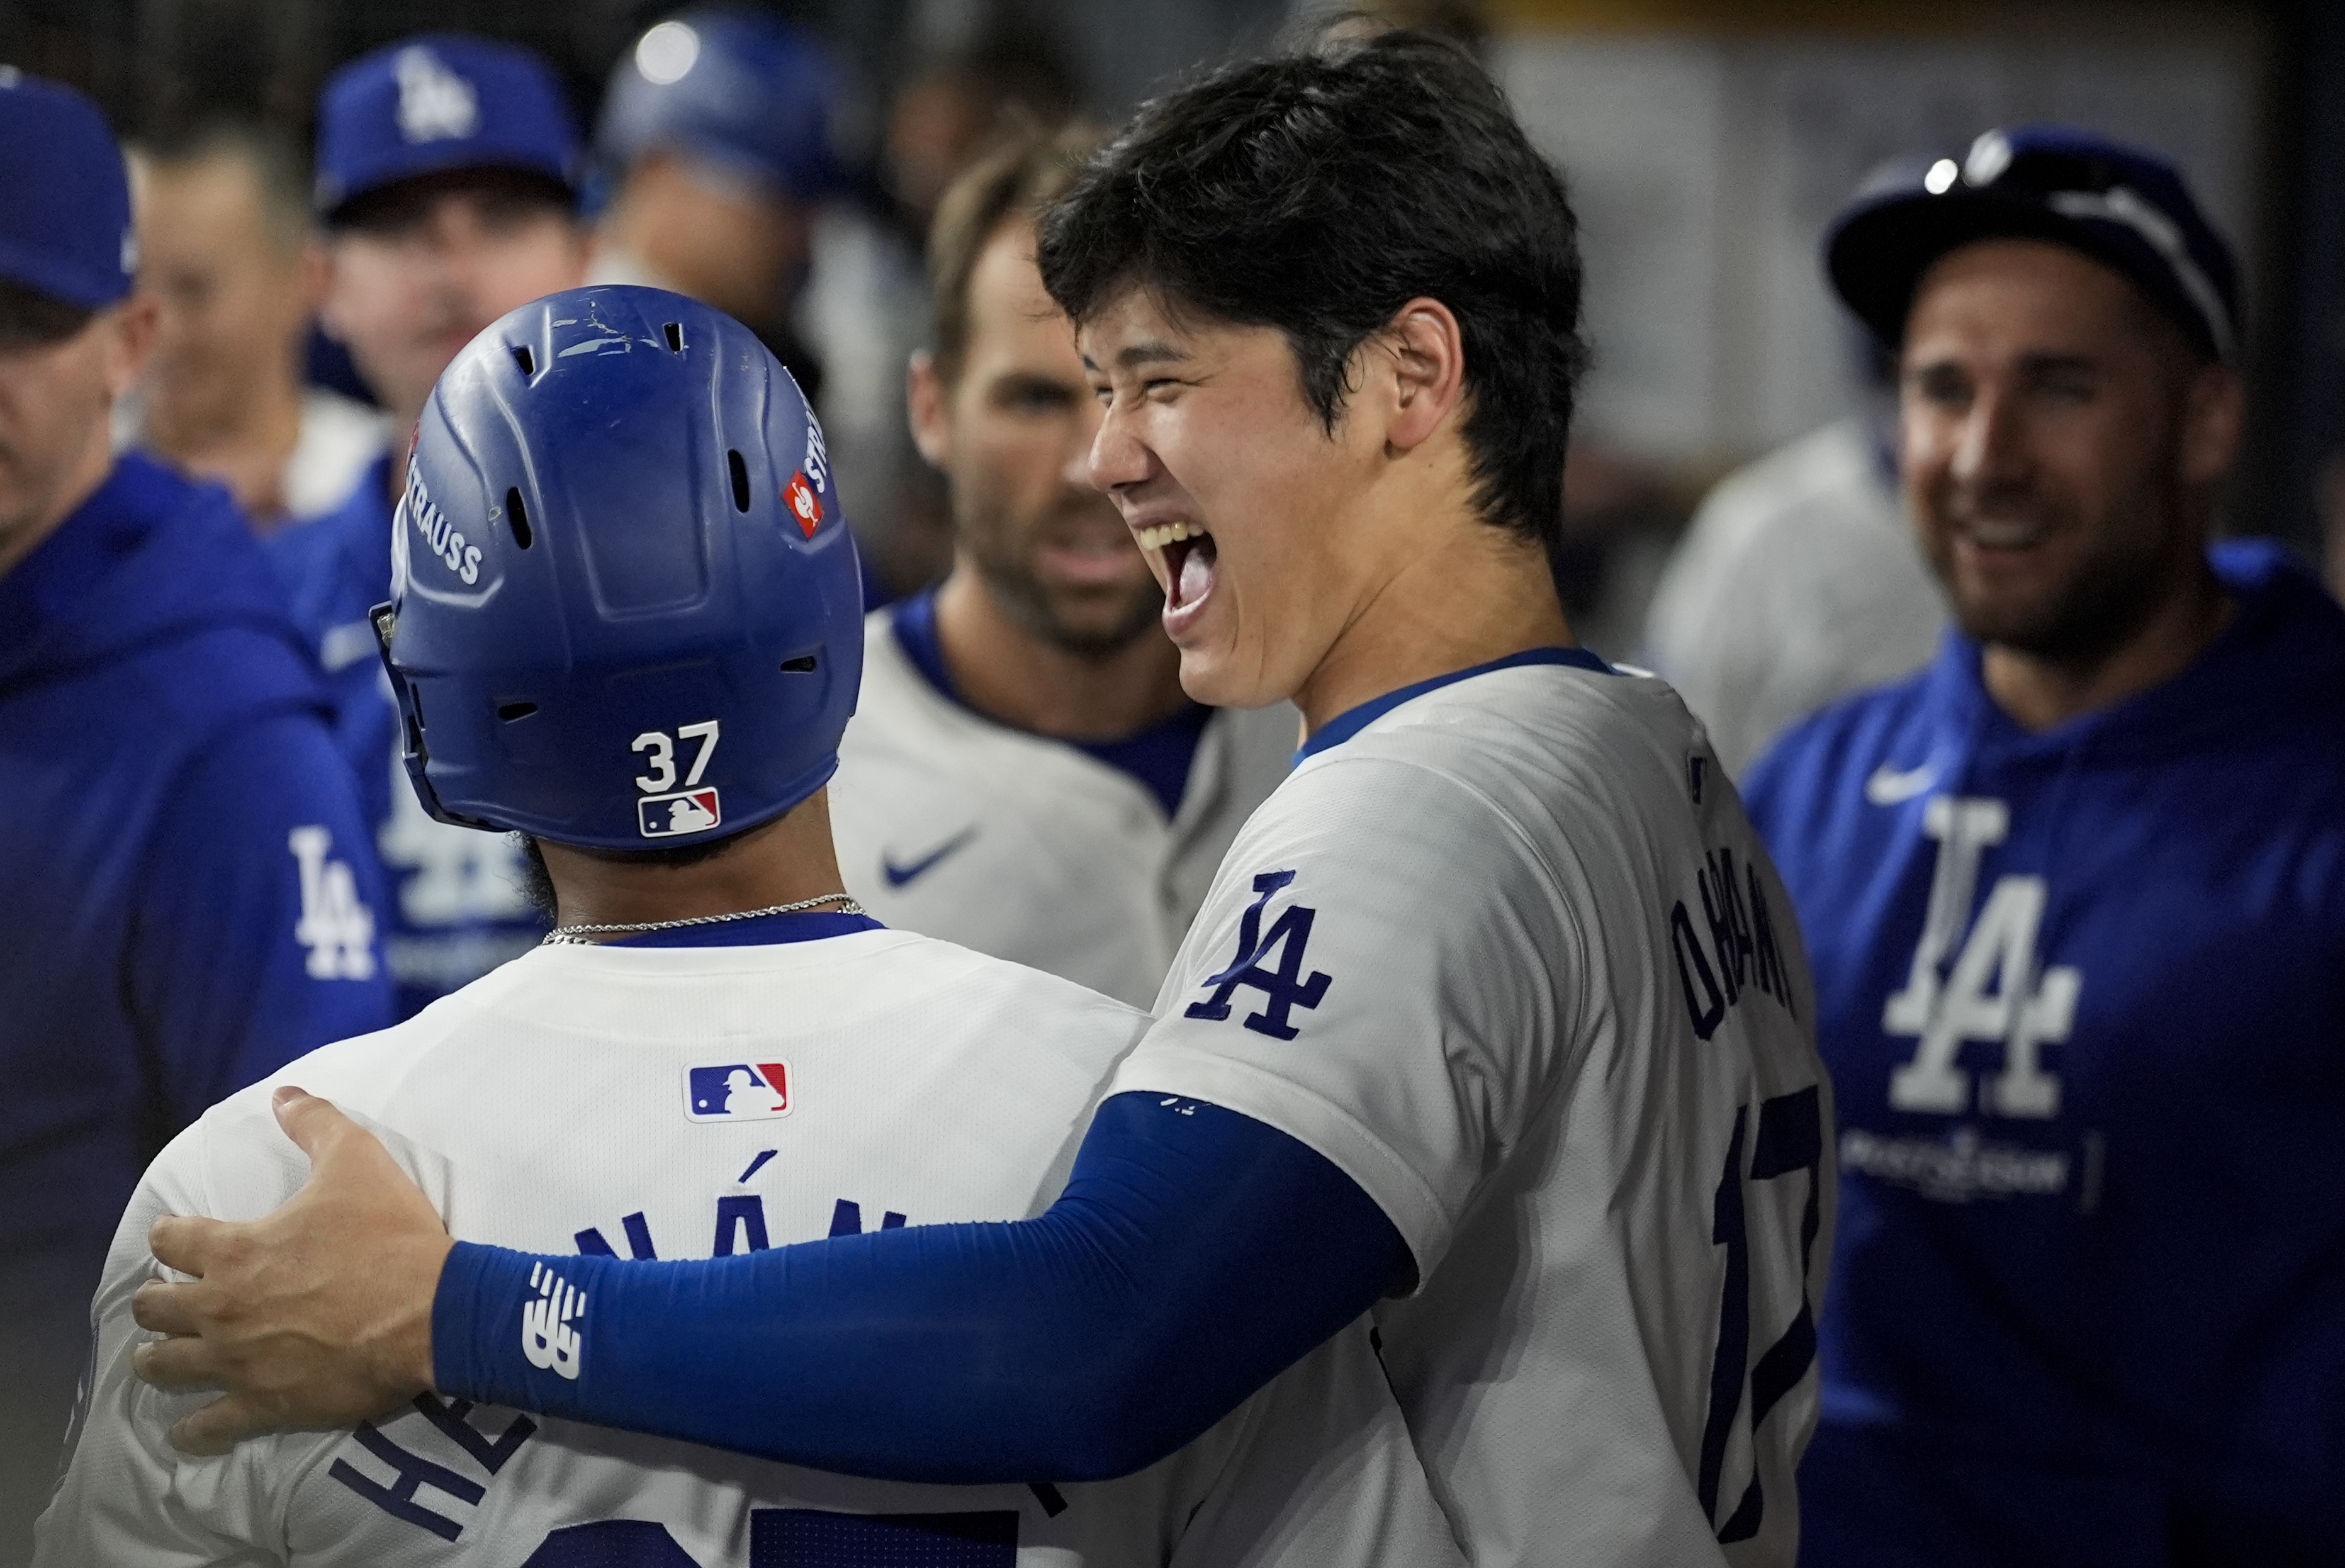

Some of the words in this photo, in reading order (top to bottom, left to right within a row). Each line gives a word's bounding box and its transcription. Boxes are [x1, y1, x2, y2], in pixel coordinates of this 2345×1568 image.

[631, 719, 721, 793] 37
[288, 824, 376, 982] LA
[1183, 869, 1333, 1041] LA
[1882, 795, 2083, 1119] LA
[1697, 1084, 1821, 1545] 17
